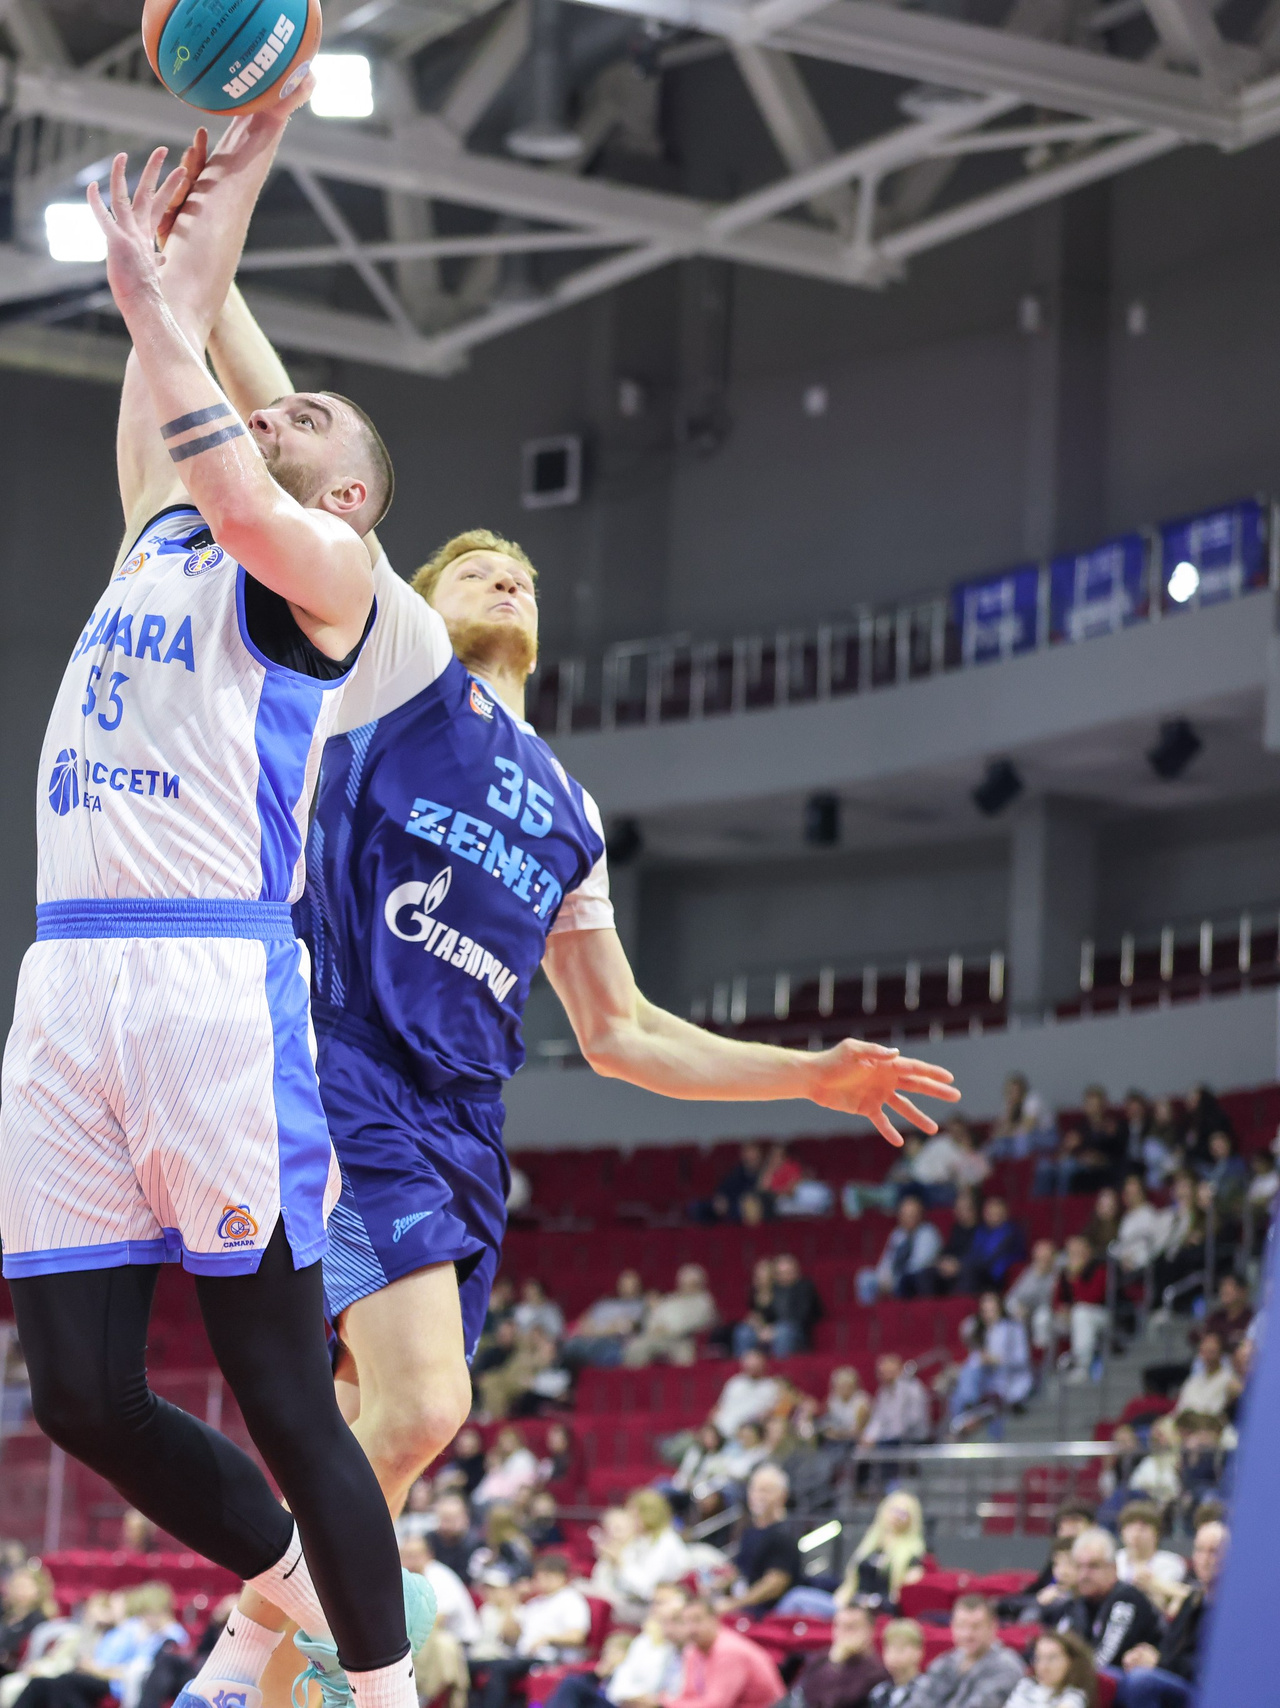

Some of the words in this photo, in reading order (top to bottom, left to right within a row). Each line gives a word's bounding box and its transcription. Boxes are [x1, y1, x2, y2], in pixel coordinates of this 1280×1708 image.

[222, 13, 295, 99] SIBUR
[82, 665, 130, 731] 53
[486, 756, 555, 839] 35
[405, 797, 563, 920] ZENIT
[424, 922, 519, 1003] ГАЗПРОМ
